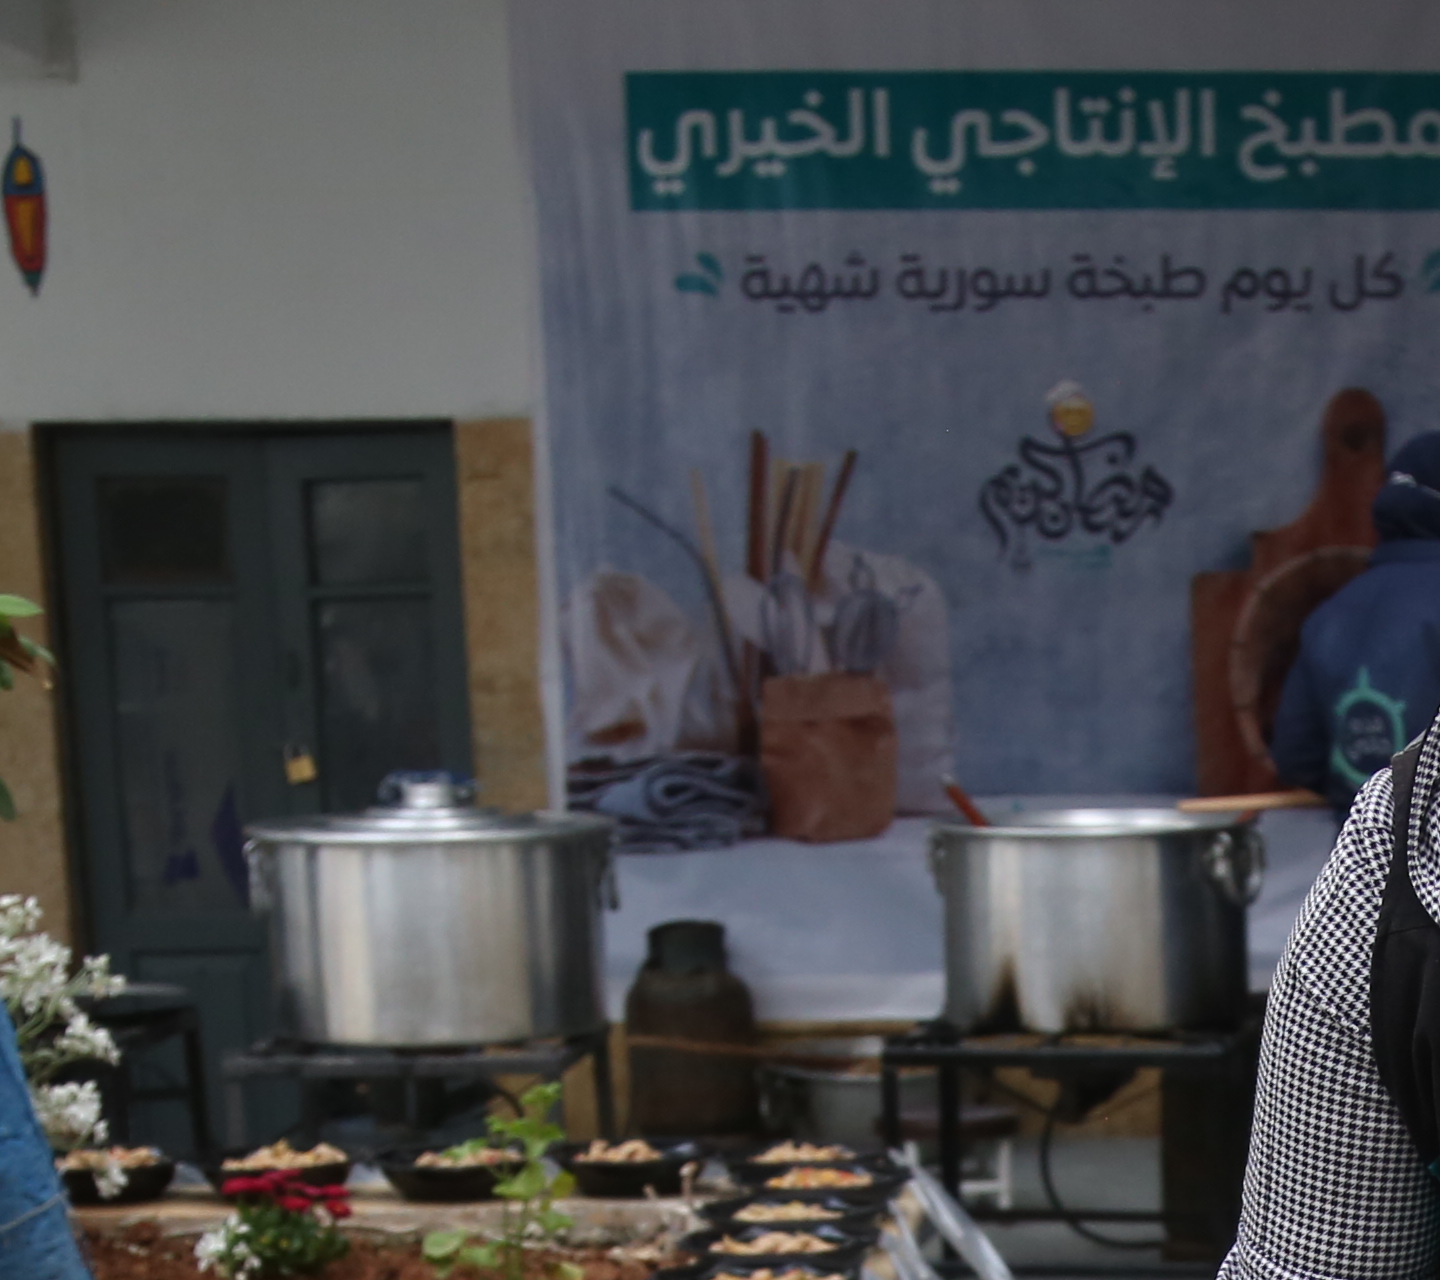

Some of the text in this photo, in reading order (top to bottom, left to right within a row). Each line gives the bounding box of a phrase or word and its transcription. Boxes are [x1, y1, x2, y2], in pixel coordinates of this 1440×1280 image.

[636, 87, 890, 195] الخيري
[911, 87, 1216, 195] الإنتاجي
[740, 251, 1406, 315] كل يوم طبخة سورية شهية
